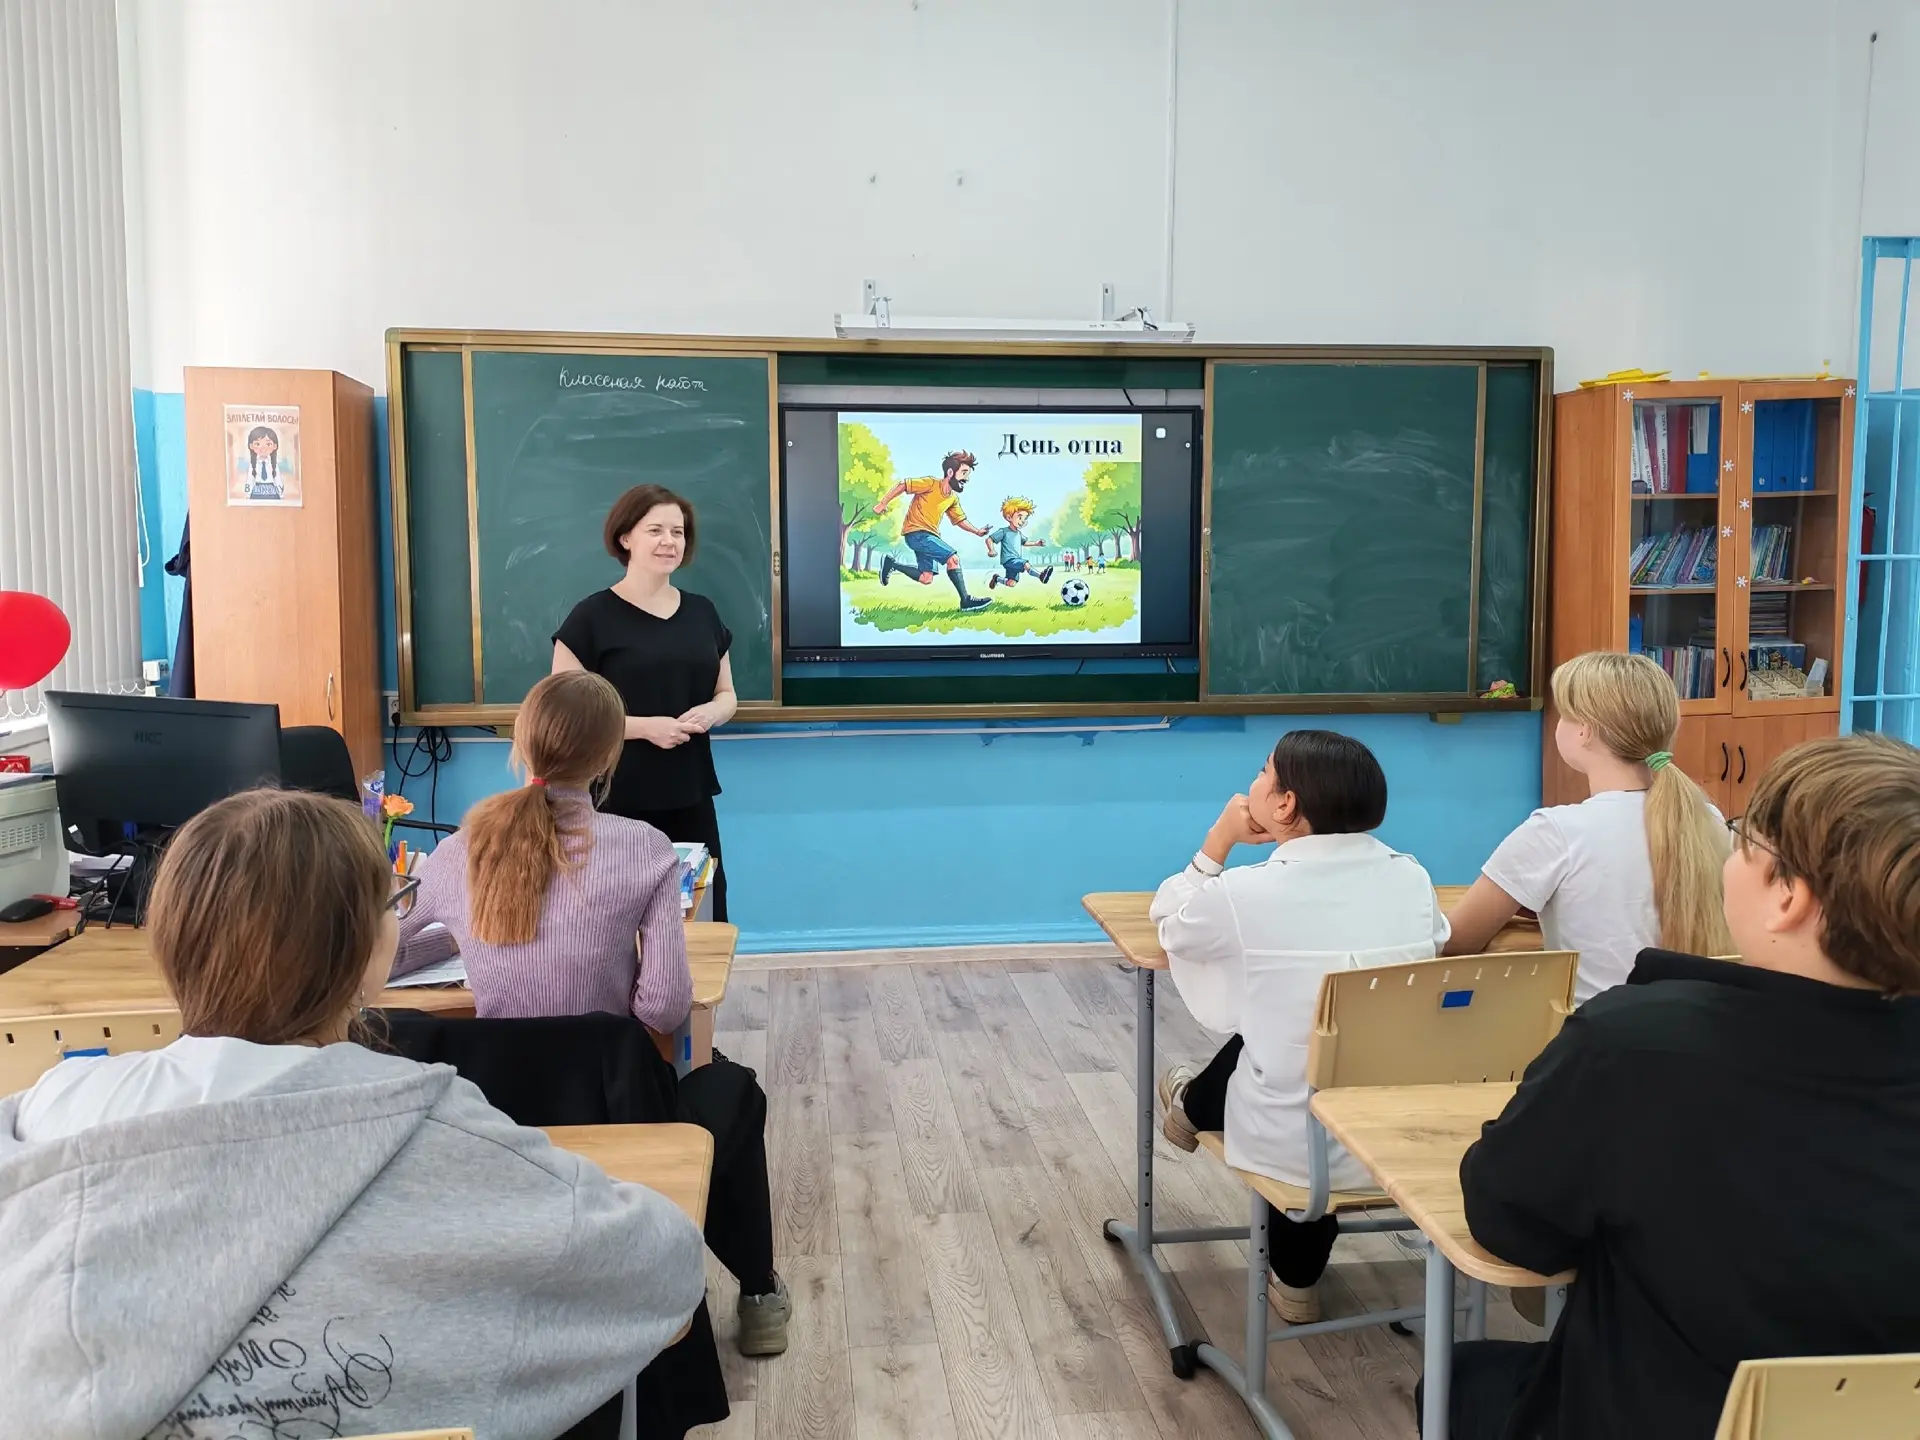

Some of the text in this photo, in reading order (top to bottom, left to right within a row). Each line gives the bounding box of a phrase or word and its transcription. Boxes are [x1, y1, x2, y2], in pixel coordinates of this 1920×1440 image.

[559, 366, 708, 392] Классная работа
[226, 411, 299, 425] ЗАПЛЕТАЙ ВОЛОСЫ
[998, 433, 1124, 460] День отца
[244, 483, 285, 495] В ШКОЛУ
